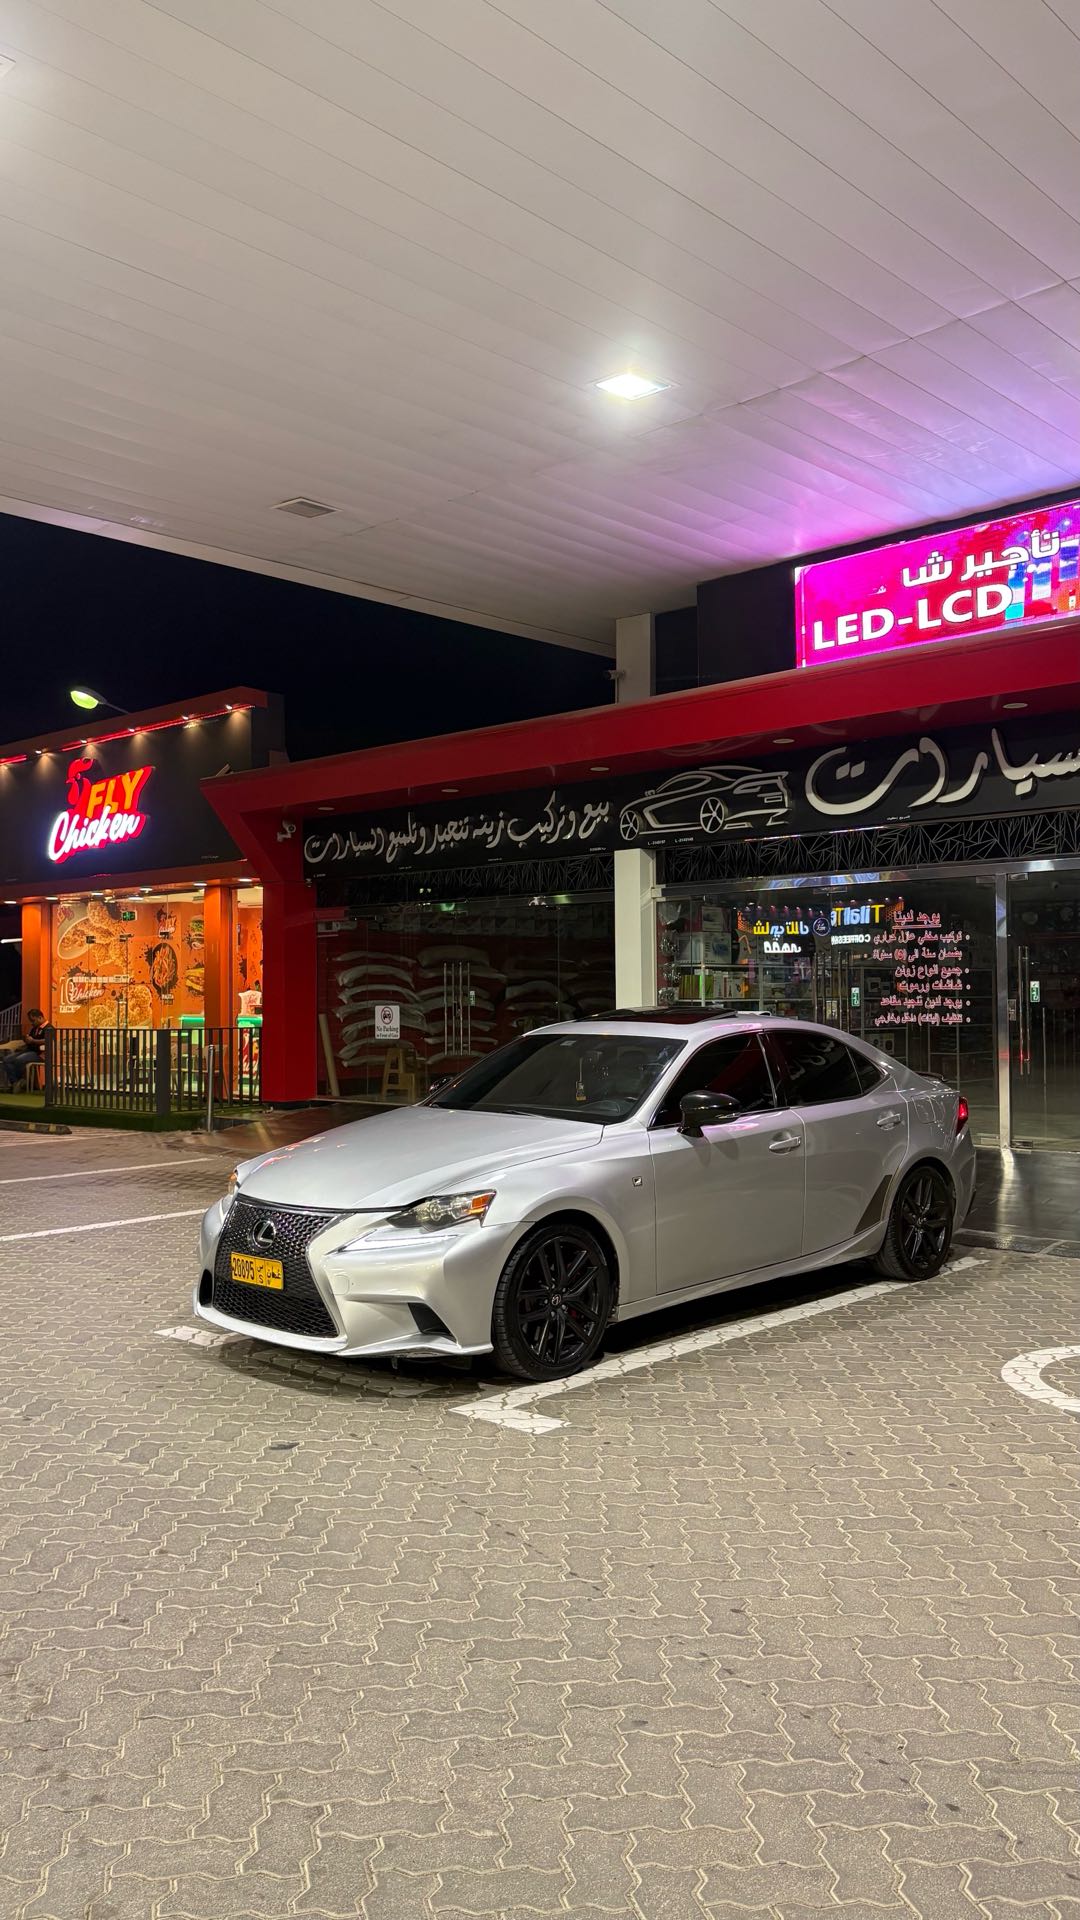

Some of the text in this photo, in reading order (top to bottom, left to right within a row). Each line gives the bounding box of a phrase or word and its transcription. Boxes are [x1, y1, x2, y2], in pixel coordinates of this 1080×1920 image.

[961, 529, 1060, 581] تأجير
[813, 584, 1013, 650] LED-LCD
[86, 768, 144, 818] FLY
[507, 790, 575, 848] وتركيب
[579, 801, 609, 839] بيع
[48, 805, 141, 862] Chicken
[304, 827, 385, 863] السيارات
[894, 909, 940, 925] يوجد لدينا
[940, 930, 962, 943] تركيب
[921, 947, 936, 958] سنة
[938, 947, 962, 960] بضمان
[941, 966, 962, 979] جميع
[932, 979, 962, 990] شاشات
[943, 997, 962, 1009] يوجد
[258, 1274, 264, 1284] S
